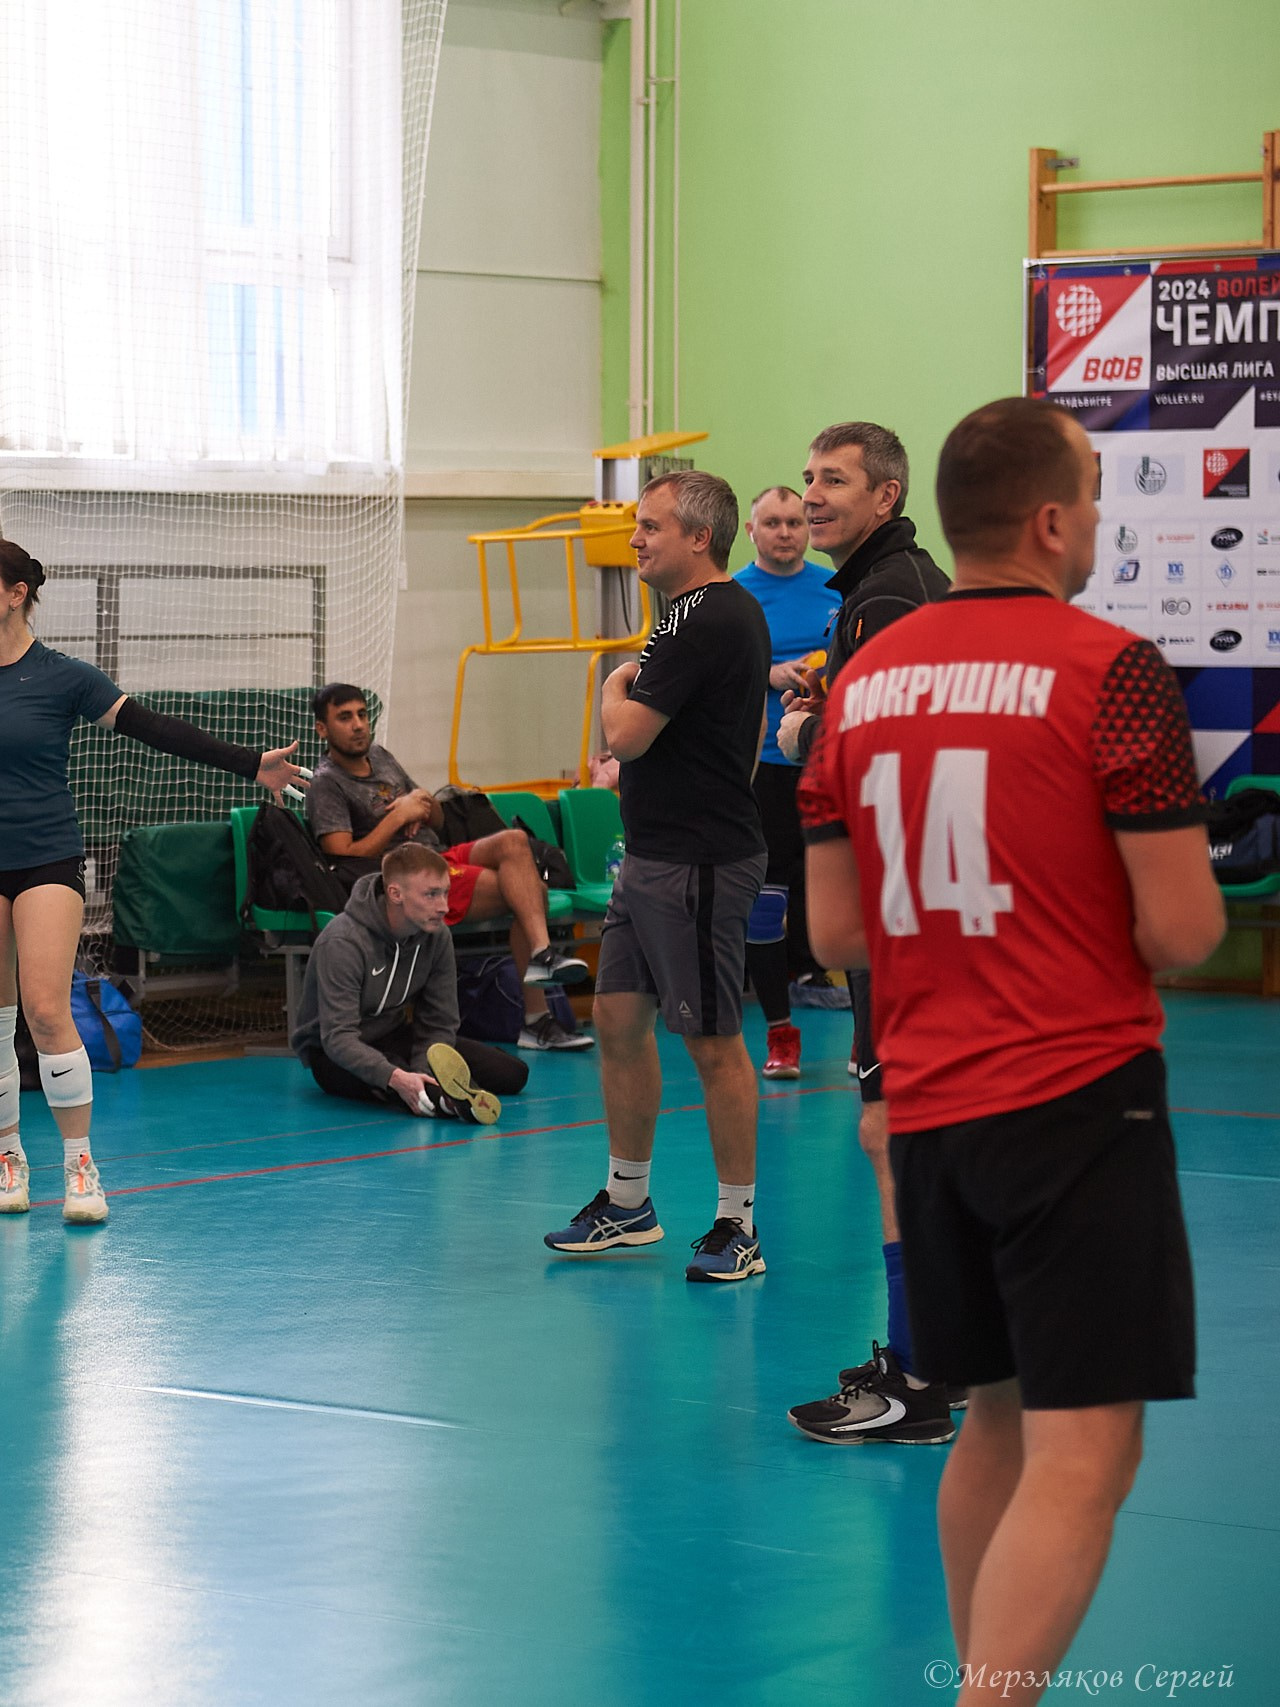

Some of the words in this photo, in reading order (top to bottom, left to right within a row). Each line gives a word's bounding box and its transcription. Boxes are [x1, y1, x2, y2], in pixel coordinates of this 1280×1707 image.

[1158, 279, 1211, 301] 2024
[1156, 301, 1280, 347] ЧЕМП
[1082, 356, 1144, 383] ВФВ
[1155, 361, 1229, 382] ВЫСШАЯ
[1231, 360, 1275, 379] ЛИГА
[1155, 393, 1205, 405] VOLLEY.RU
[838, 661, 1057, 733] МОКРУШИН
[859, 748, 1014, 937] 14
